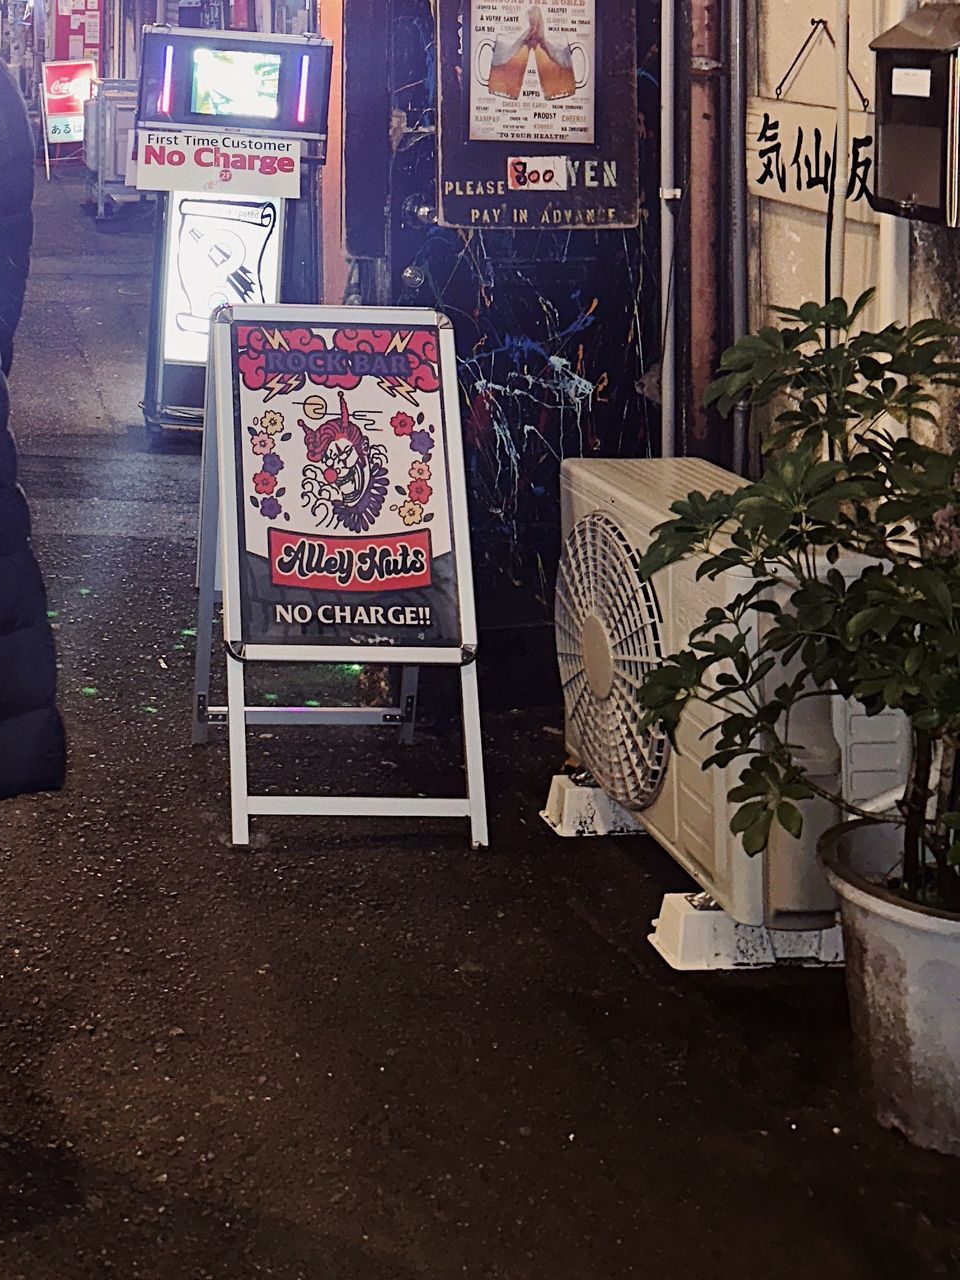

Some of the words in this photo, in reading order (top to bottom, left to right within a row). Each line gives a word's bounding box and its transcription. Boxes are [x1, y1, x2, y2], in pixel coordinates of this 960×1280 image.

[148, 134, 179, 145] First
[184, 136, 218, 146] Time
[223, 137, 292, 152] Customer
[144, 145, 186, 166] No
[194, 147, 294, 175] Charge
[221, 172, 232, 180] 2F
[445, 181, 505, 195] PLEASE
[567, 160, 617, 187] YEN
[471, 209, 500, 223] PAY
[514, 209, 528, 223] IN
[267, 352, 342, 372] ROCK
[354, 354, 410, 374] BAR
[278, 540, 354, 584] Alley
[357, 544, 426, 582] Nuts
[276, 604, 312, 624] NO
[318, 605, 430, 625] CHARGE!!
